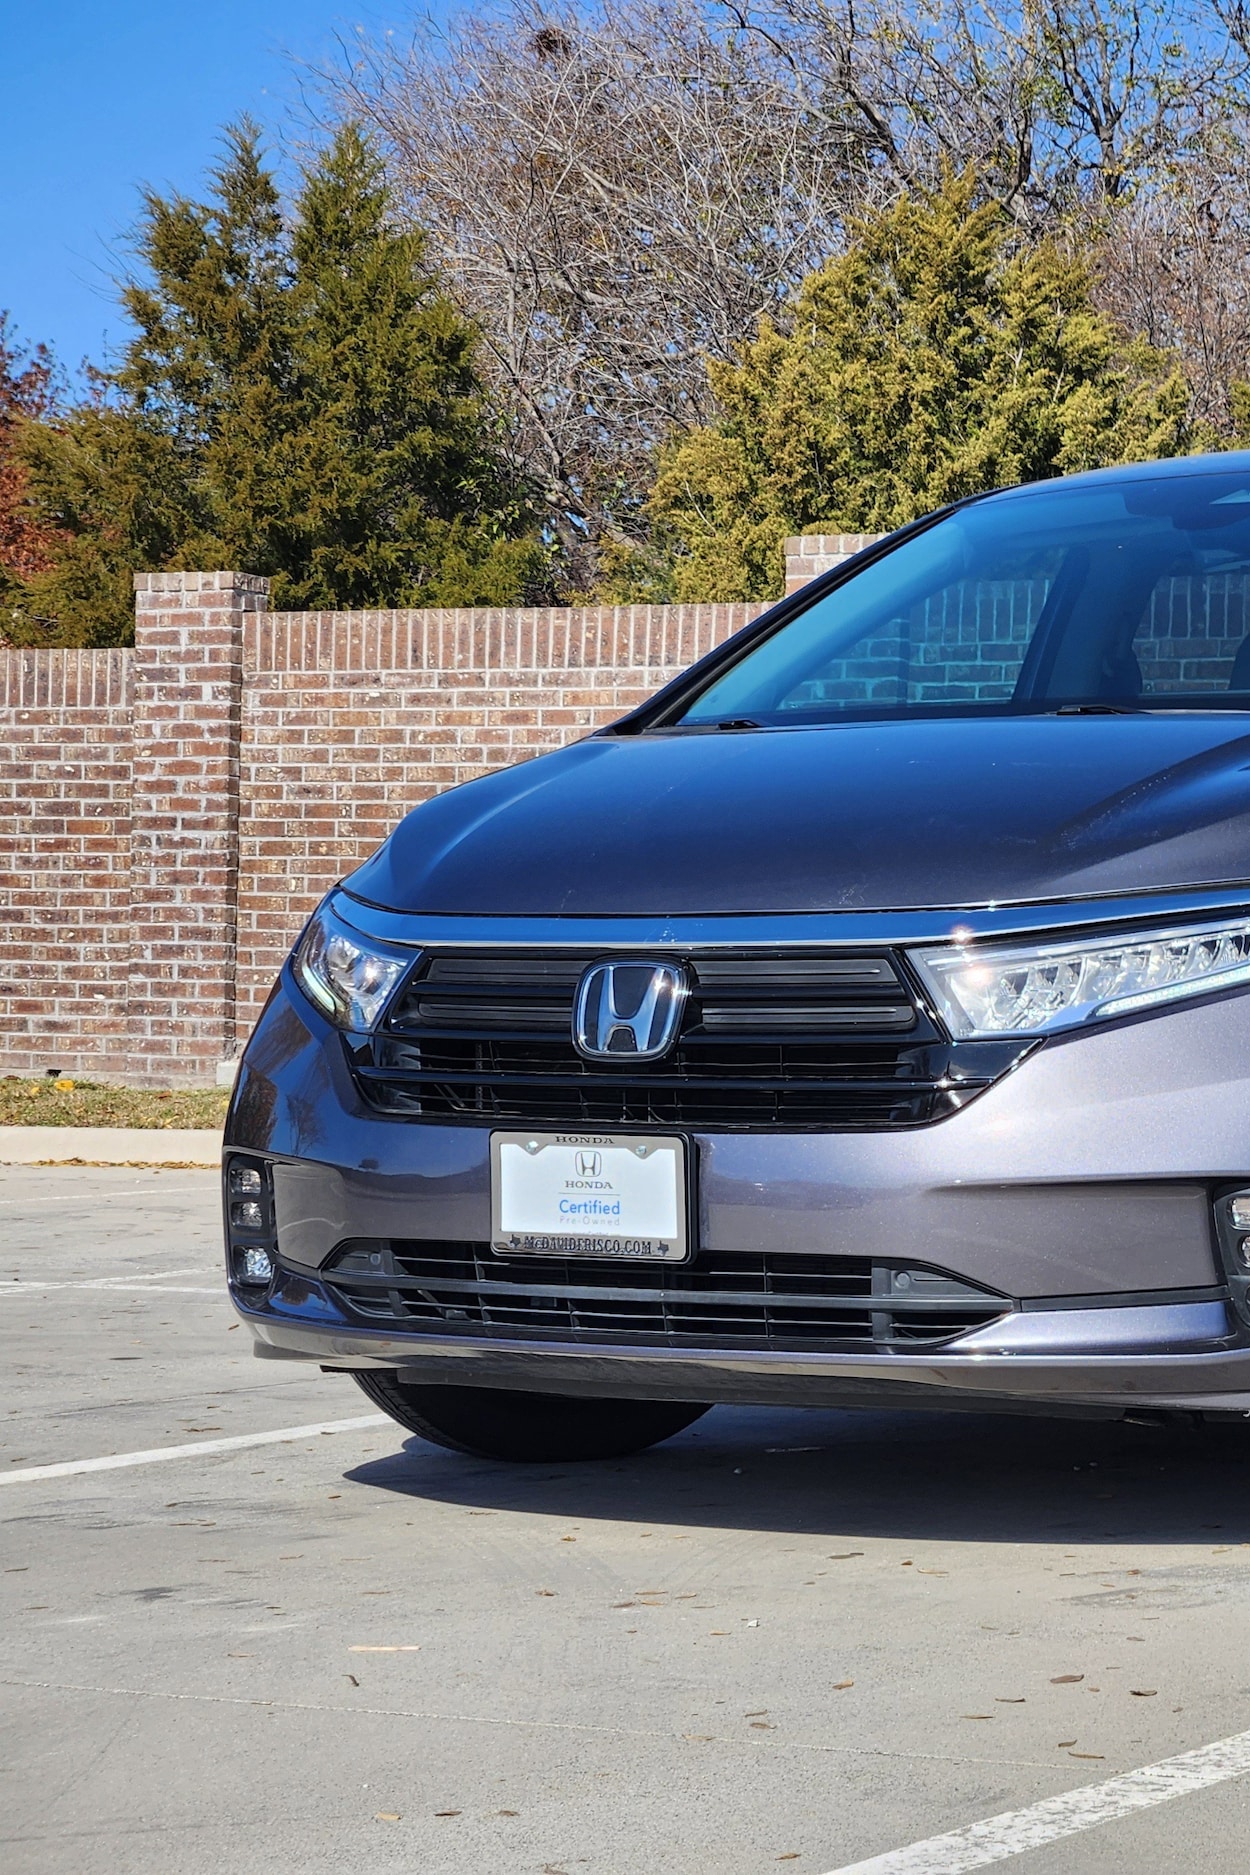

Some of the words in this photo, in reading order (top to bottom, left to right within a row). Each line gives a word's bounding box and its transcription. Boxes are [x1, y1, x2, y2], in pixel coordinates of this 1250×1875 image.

[555, 1135, 615, 1145] HONDA
[565, 1180, 614, 1190] HONDA
[559, 1199, 620, 1215] Certified
[559, 1216, 620, 1227] Pre-Owned
